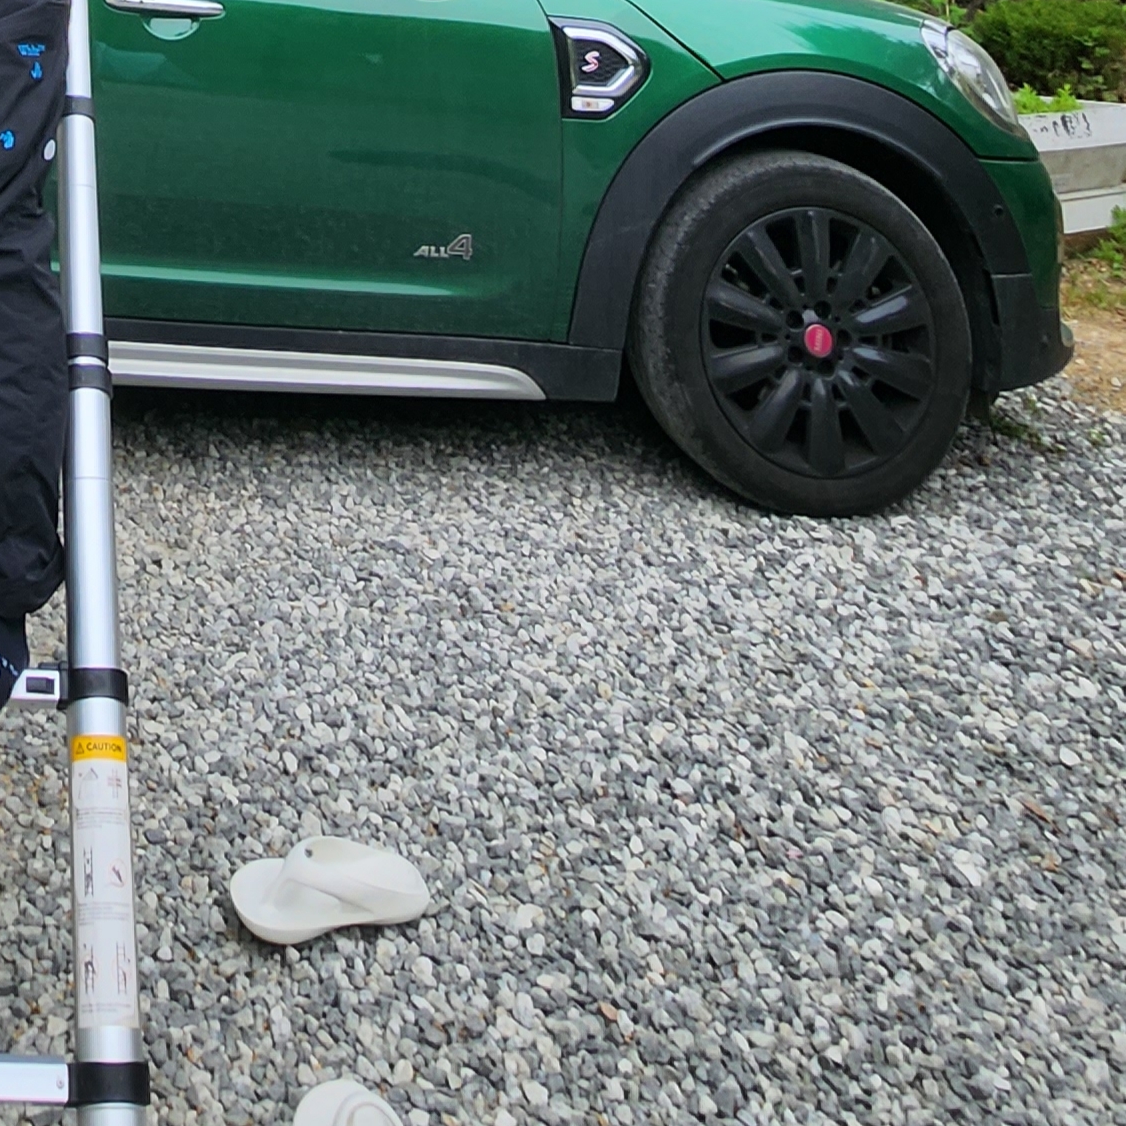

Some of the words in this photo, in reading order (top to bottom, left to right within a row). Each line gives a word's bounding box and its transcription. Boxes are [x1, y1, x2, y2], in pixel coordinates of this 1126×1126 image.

[581, 51, 600, 73] S
[413, 234, 473, 261] ALL4
[86, 742, 122, 753] CAUTION
